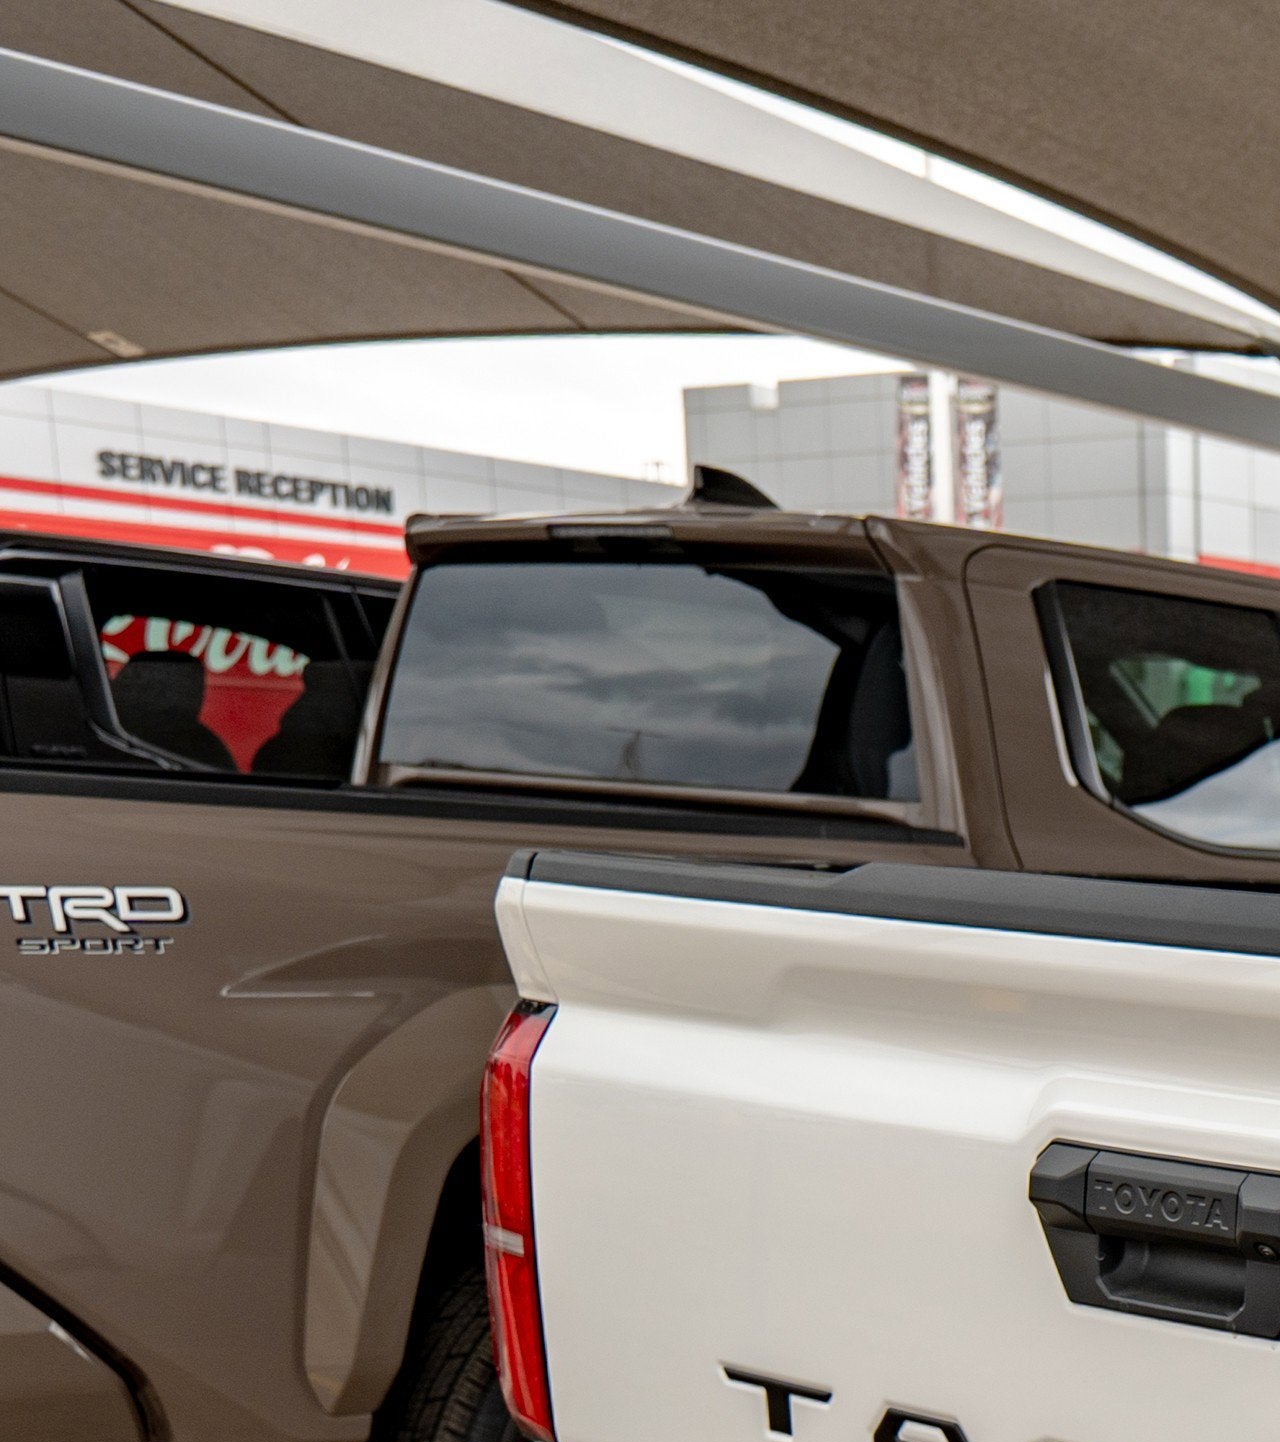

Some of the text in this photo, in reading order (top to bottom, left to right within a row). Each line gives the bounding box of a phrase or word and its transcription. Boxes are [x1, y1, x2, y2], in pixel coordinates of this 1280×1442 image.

[96, 449, 395, 513] SERVICE RECEPTION
[0, 885, 186, 933] TRD
[16, 936, 175, 956] SPORT
[1093, 1178, 1230, 1232] TOYOTA
